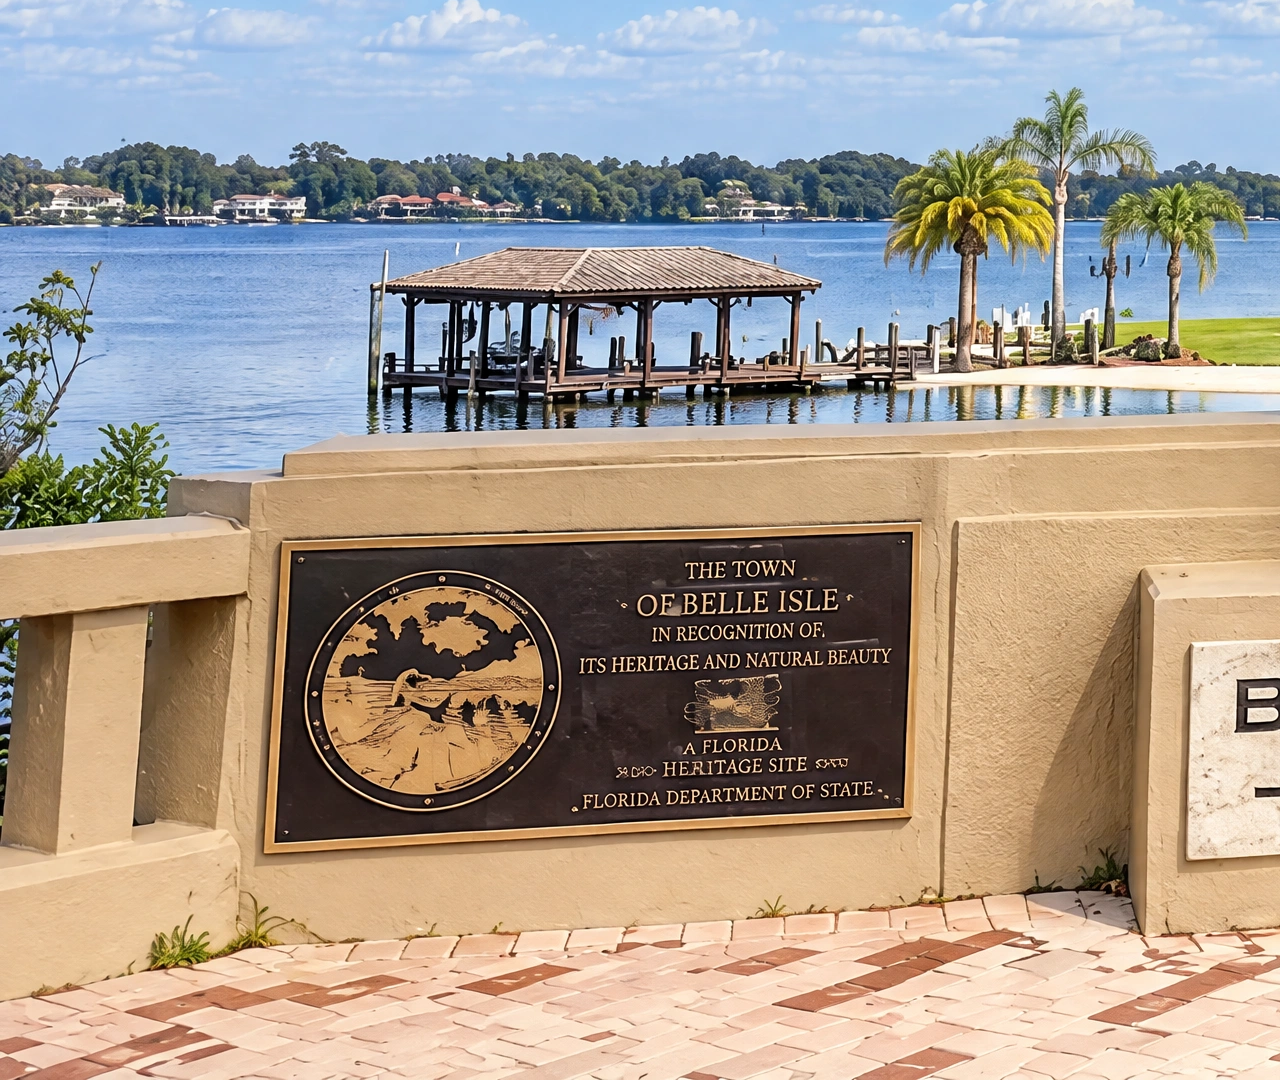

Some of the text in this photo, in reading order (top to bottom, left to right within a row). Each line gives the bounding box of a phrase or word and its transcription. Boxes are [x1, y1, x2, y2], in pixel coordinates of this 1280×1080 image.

[684, 559, 796, 580] THE TOWN
[636, 588, 840, 617] OF BELLE ISLE
[651, 626, 672, 643] IN
[675, 622, 795, 642] RECOGNITION
[578, 647, 892, 675] ITS HERITAGE AND NATURAL BEAUTY
[682, 736, 783, 755] A FLORIDA
[662, 758, 763, 778] HERITAGE
[768, 756, 808, 773] SITE
[582, 790, 661, 810] FLORIDA
[665, 785, 787, 806] DEPARTMENT
[791, 784, 815, 800] OF
